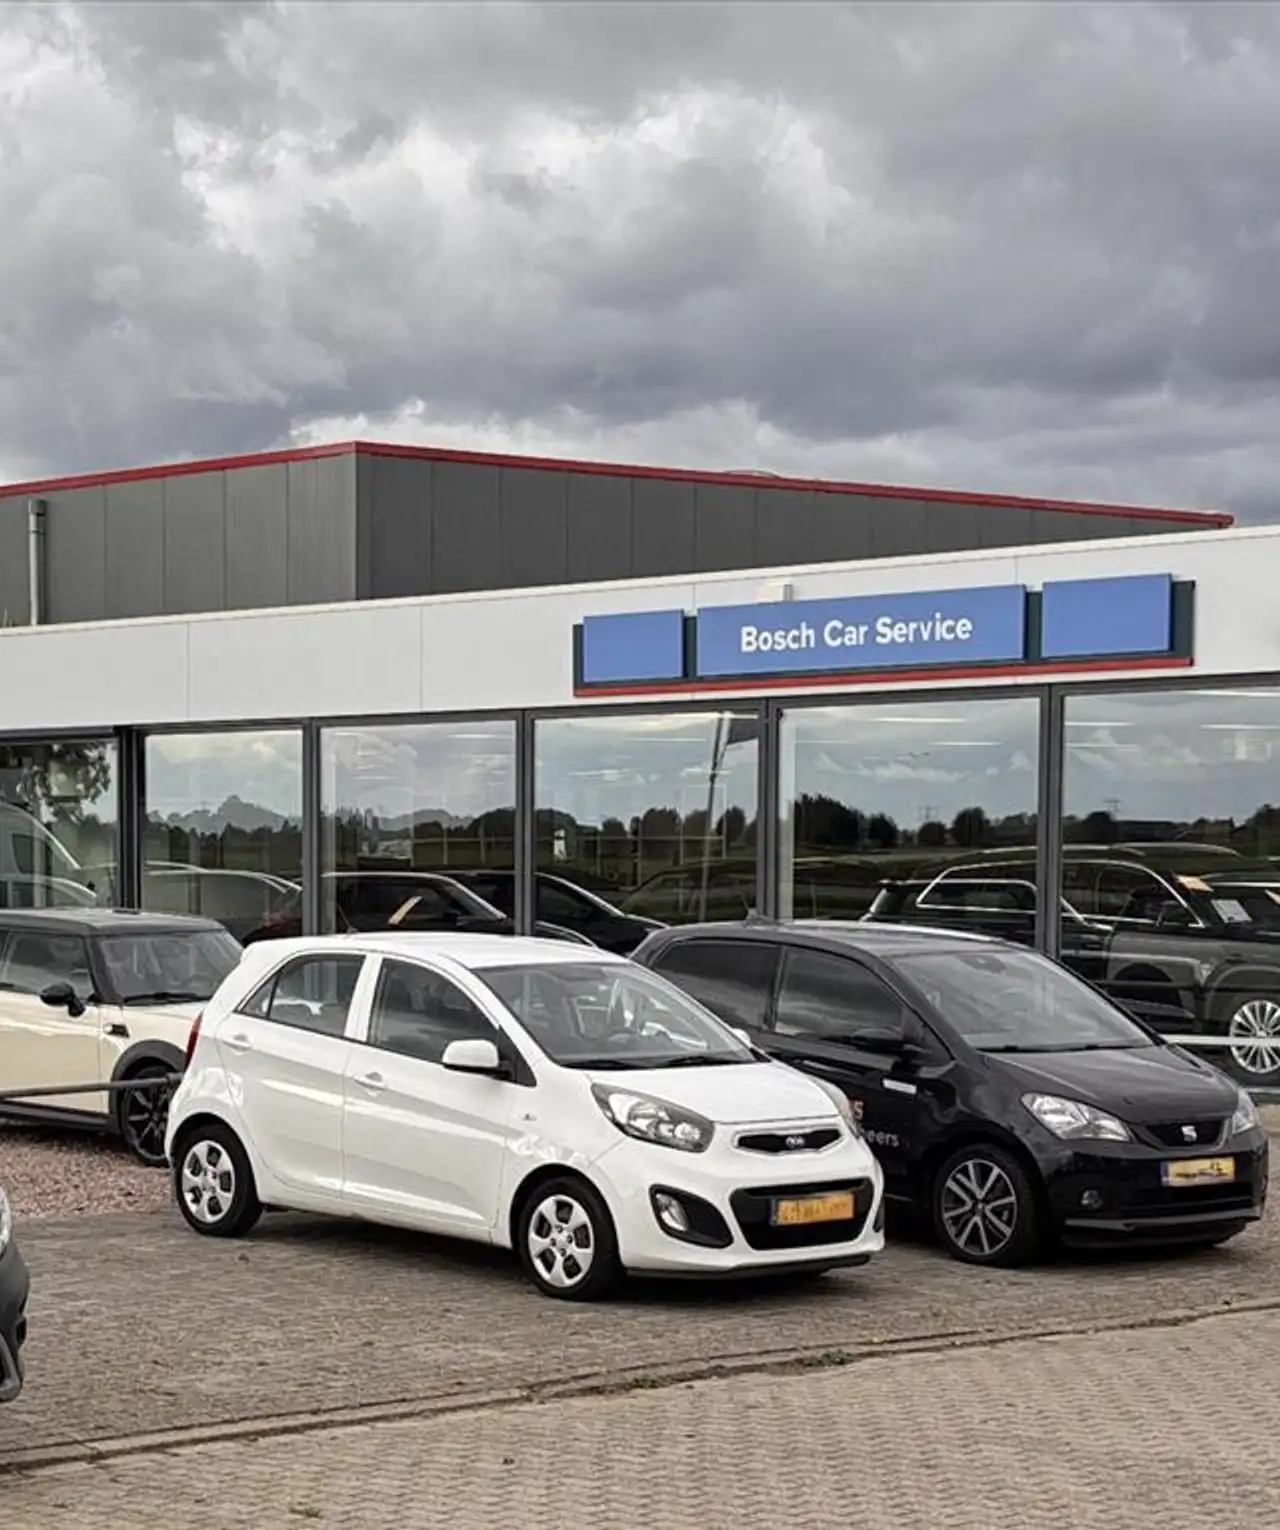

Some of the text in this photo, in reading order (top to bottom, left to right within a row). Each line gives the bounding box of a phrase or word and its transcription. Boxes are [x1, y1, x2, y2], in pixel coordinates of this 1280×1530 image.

[740, 612, 974, 653] Bosch Car Service
